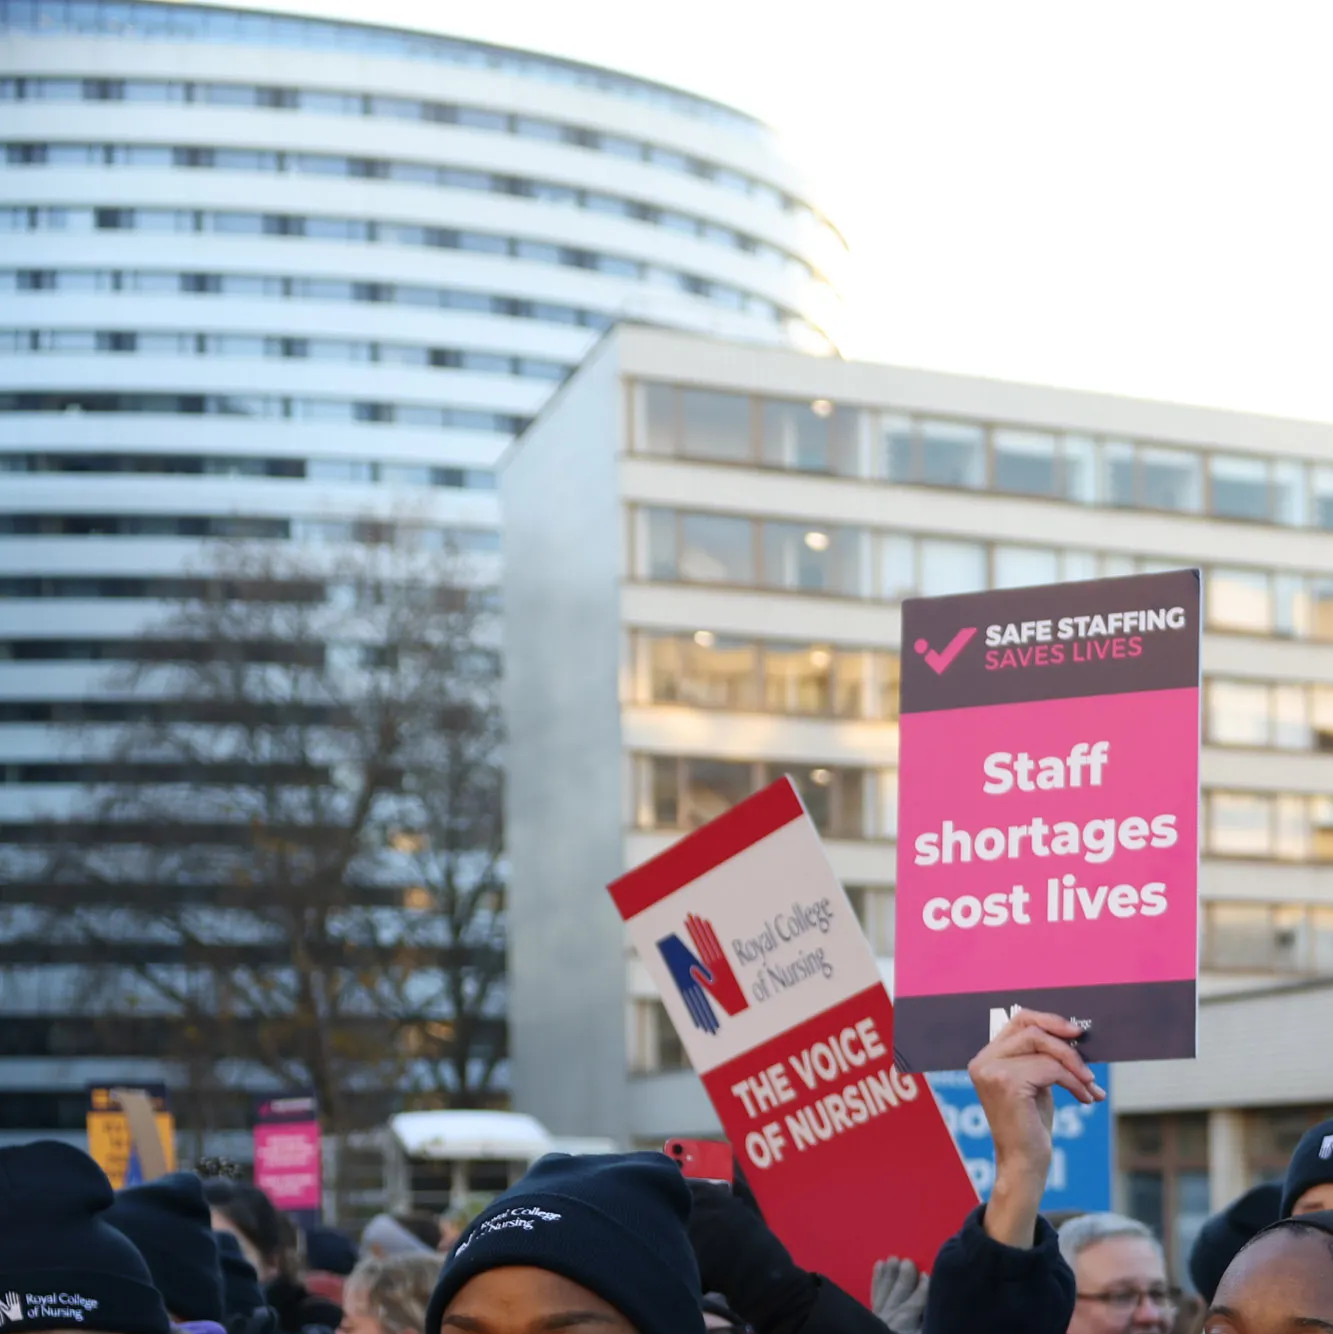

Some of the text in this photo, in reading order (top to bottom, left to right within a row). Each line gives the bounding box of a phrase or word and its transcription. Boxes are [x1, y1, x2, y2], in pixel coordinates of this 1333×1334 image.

[984, 636, 1143, 670] SAVES LIVES
[985, 607, 1186, 647] SAFE STAFFING
[982, 741, 1110, 795] Staff
[913, 813, 1179, 867] shortages
[921, 873, 1168, 931] cost lives
[731, 897, 834, 968] Royal College
[751, 945, 833, 1003] of Nursing
[730, 1016, 888, 1119] THE VOICE
[744, 1121, 788, 1169] OF
[784, 1064, 919, 1151] NURSING
[25, 1292, 99, 1311] Royal College
[27, 1305, 84, 1321] of Nursing
